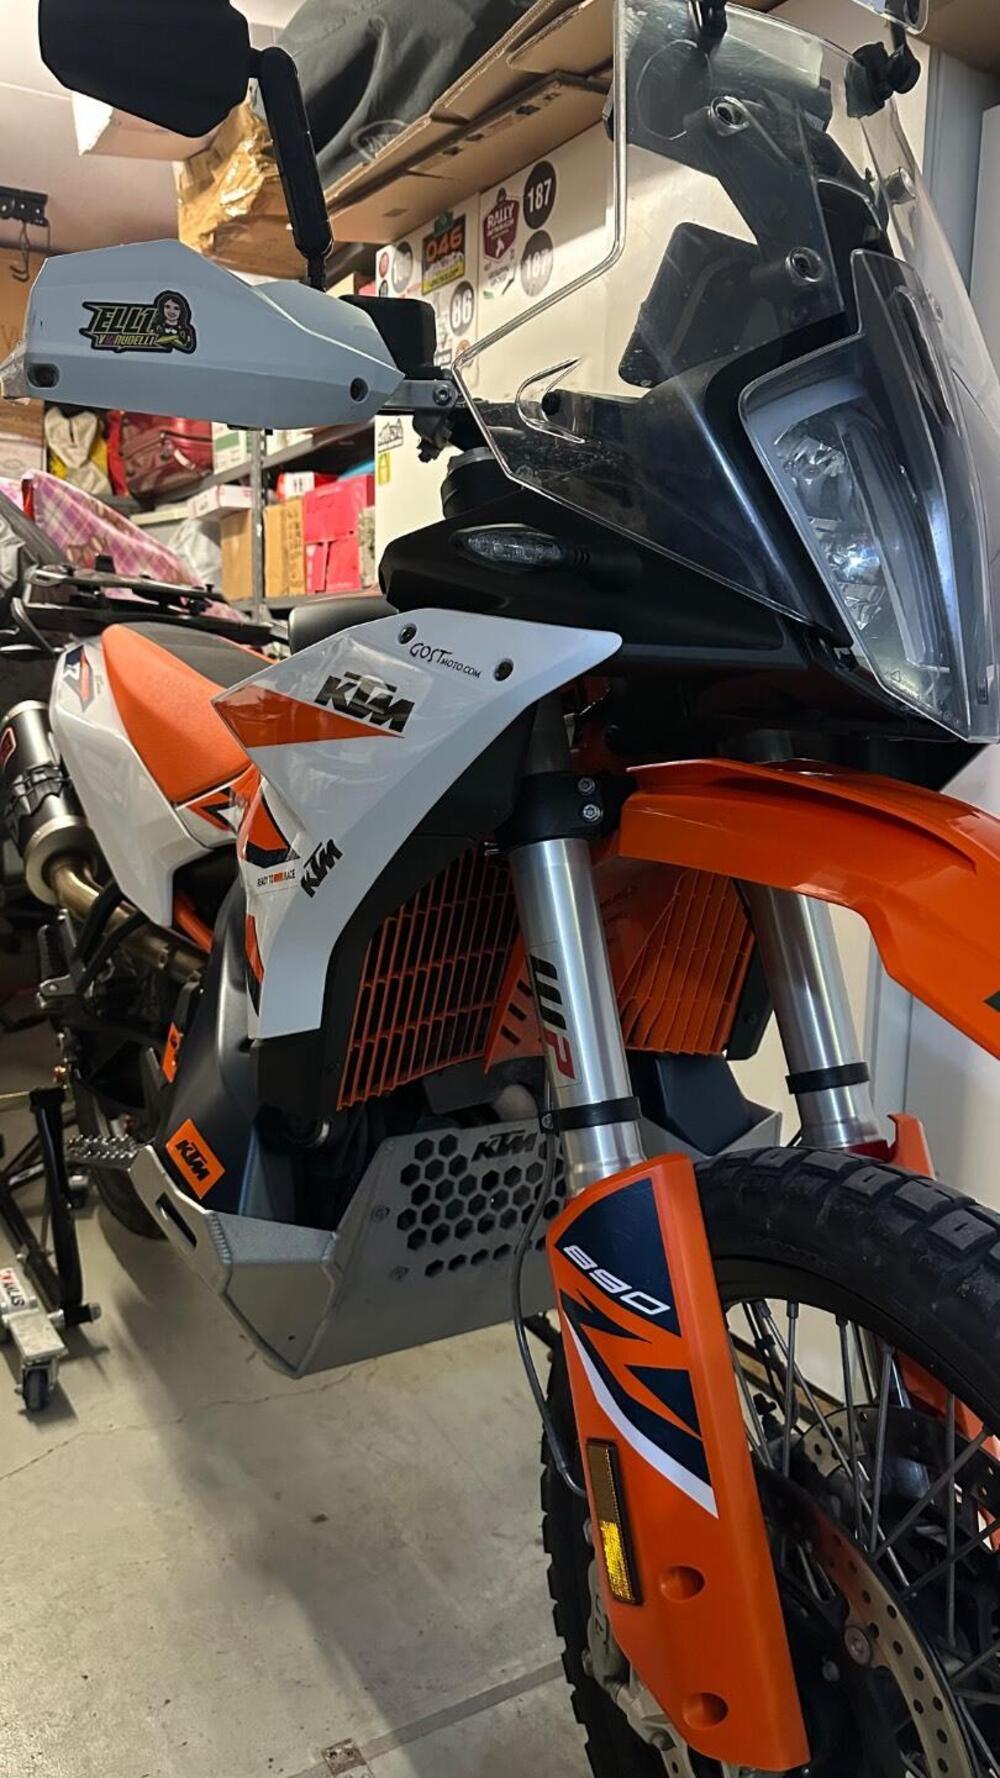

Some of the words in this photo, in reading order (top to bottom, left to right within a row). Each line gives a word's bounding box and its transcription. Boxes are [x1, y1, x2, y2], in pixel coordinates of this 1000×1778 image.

[487, 202, 515, 229] RALLY
[527, 178, 552, 213] 187
[525, 248, 551, 280] 187
[451, 288, 473, 330] 86
[314, 671, 415, 733] KTM
[300, 838, 343, 898] KTM
[176, 1140, 210, 1181] KTM
[470, 1129, 538, 1162] KTM
[562, 1244, 671, 1316] 890
